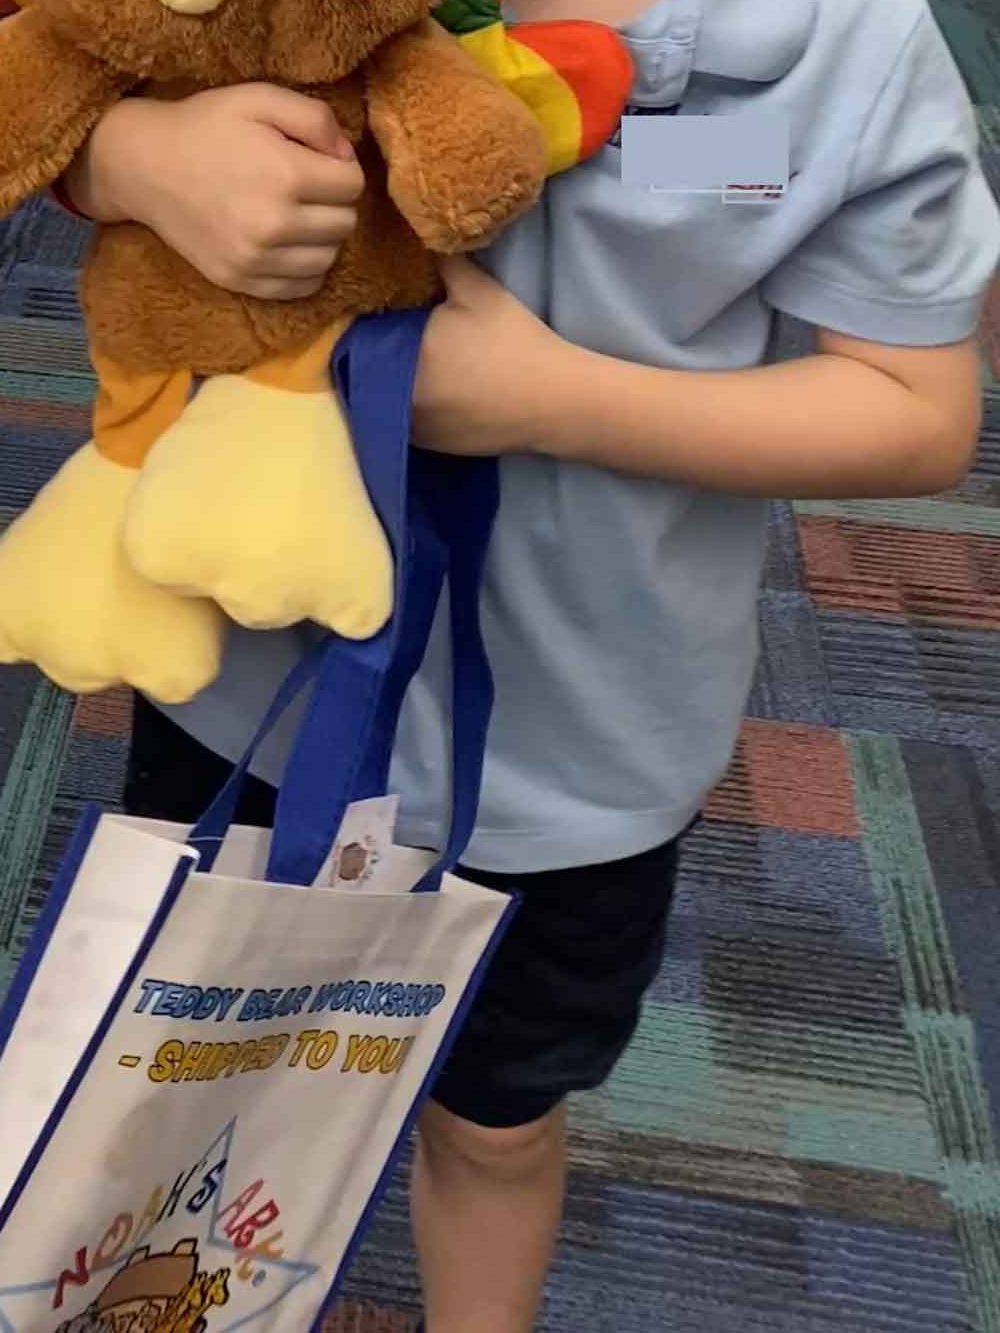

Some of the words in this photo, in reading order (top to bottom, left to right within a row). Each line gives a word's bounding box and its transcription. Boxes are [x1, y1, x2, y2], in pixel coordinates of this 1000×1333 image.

[133, 978, 244, 1022] TEDDY
[236, 985, 313, 1021] BEAR
[308, 979, 446, 1018] WORKSHOP
[147, 1033, 291, 1083] SHIPPED
[288, 1029, 339, 1071] TO
